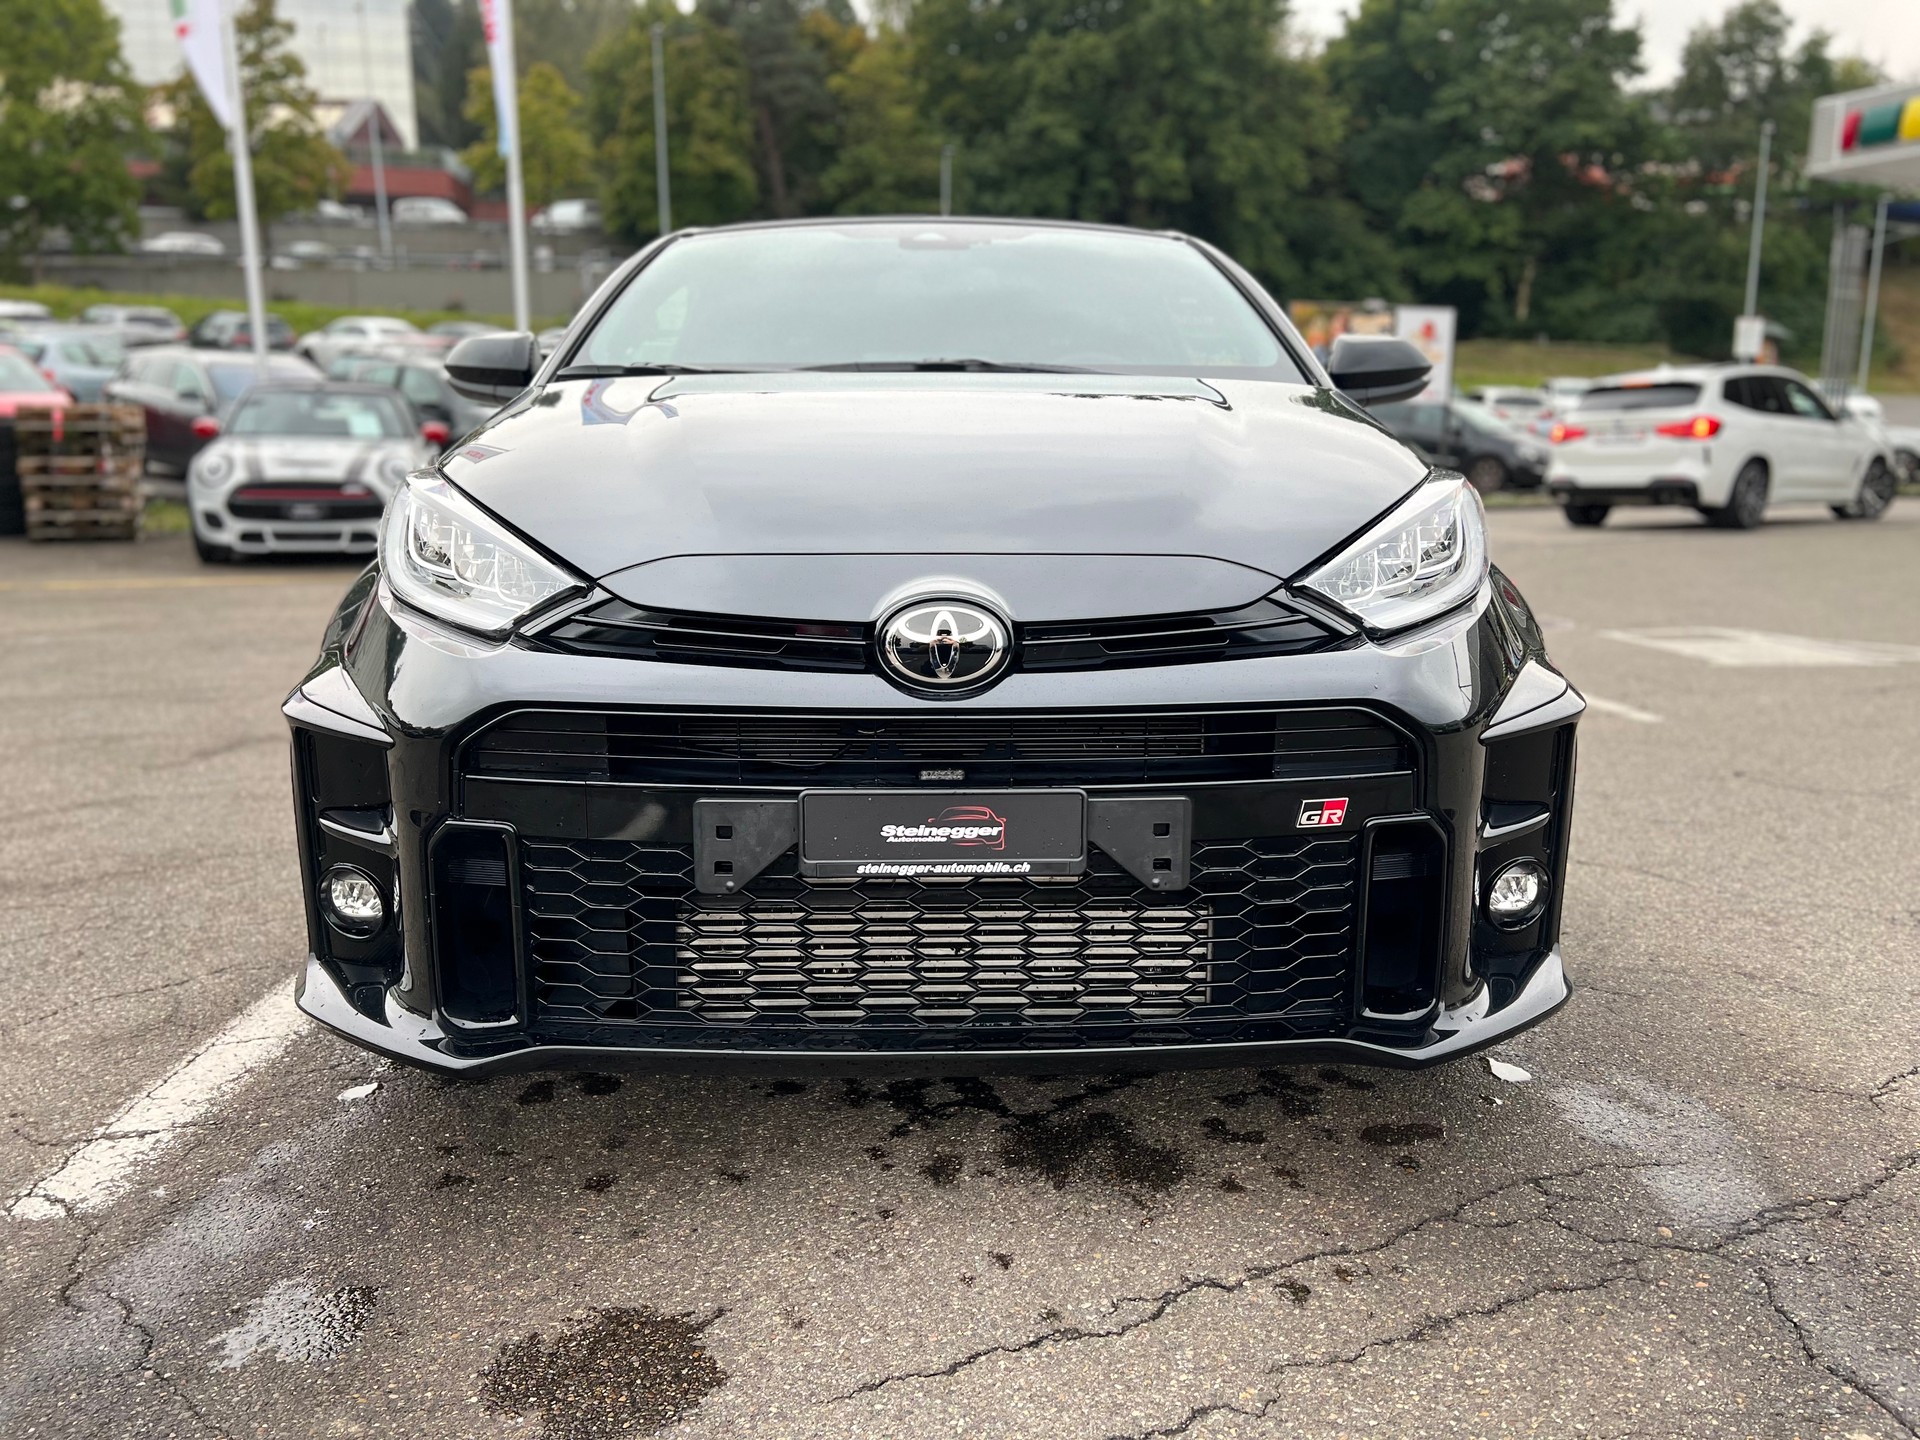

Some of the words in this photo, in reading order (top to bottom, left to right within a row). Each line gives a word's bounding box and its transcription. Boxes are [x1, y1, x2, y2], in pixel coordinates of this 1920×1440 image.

[1300, 809, 1343, 825] GR
[880, 824, 1003, 839] Steinegger
[856, 861, 1031, 876] steinegger-automobile.ch
